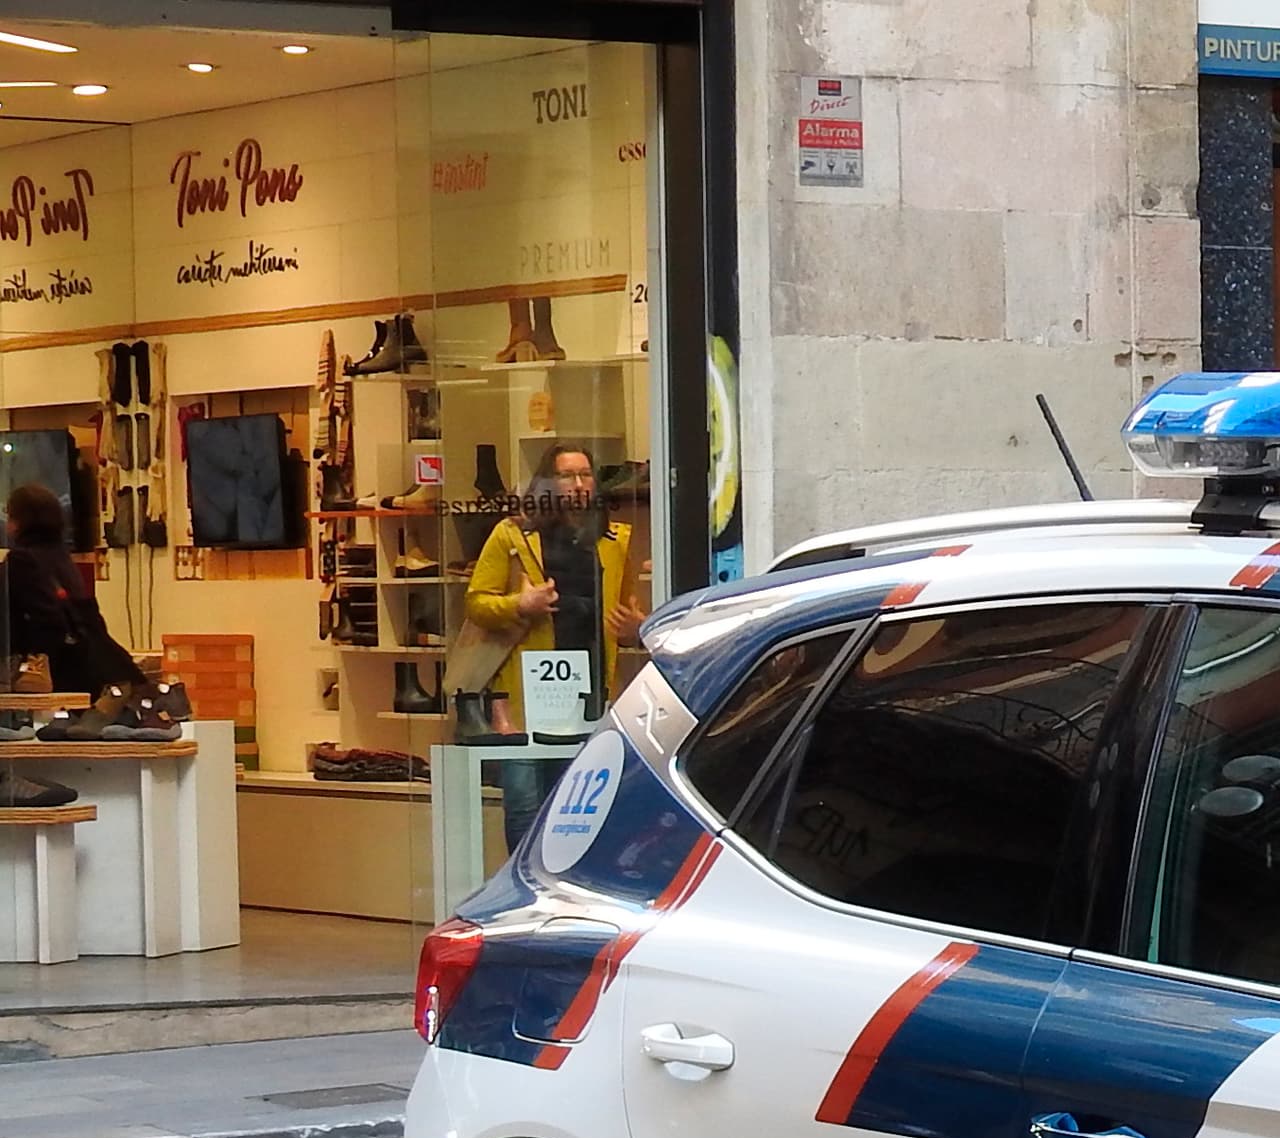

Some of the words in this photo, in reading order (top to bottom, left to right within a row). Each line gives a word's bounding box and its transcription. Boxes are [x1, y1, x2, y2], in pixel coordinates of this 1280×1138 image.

[533, 84, 588, 124] TONI
[803, 122, 860, 138] Alarma
[170, 150, 229, 228] Toni
[235, 137, 303, 218] Pons
[520, 239, 611, 273] PREMIUM
[560, 768, 610, 814] 112
